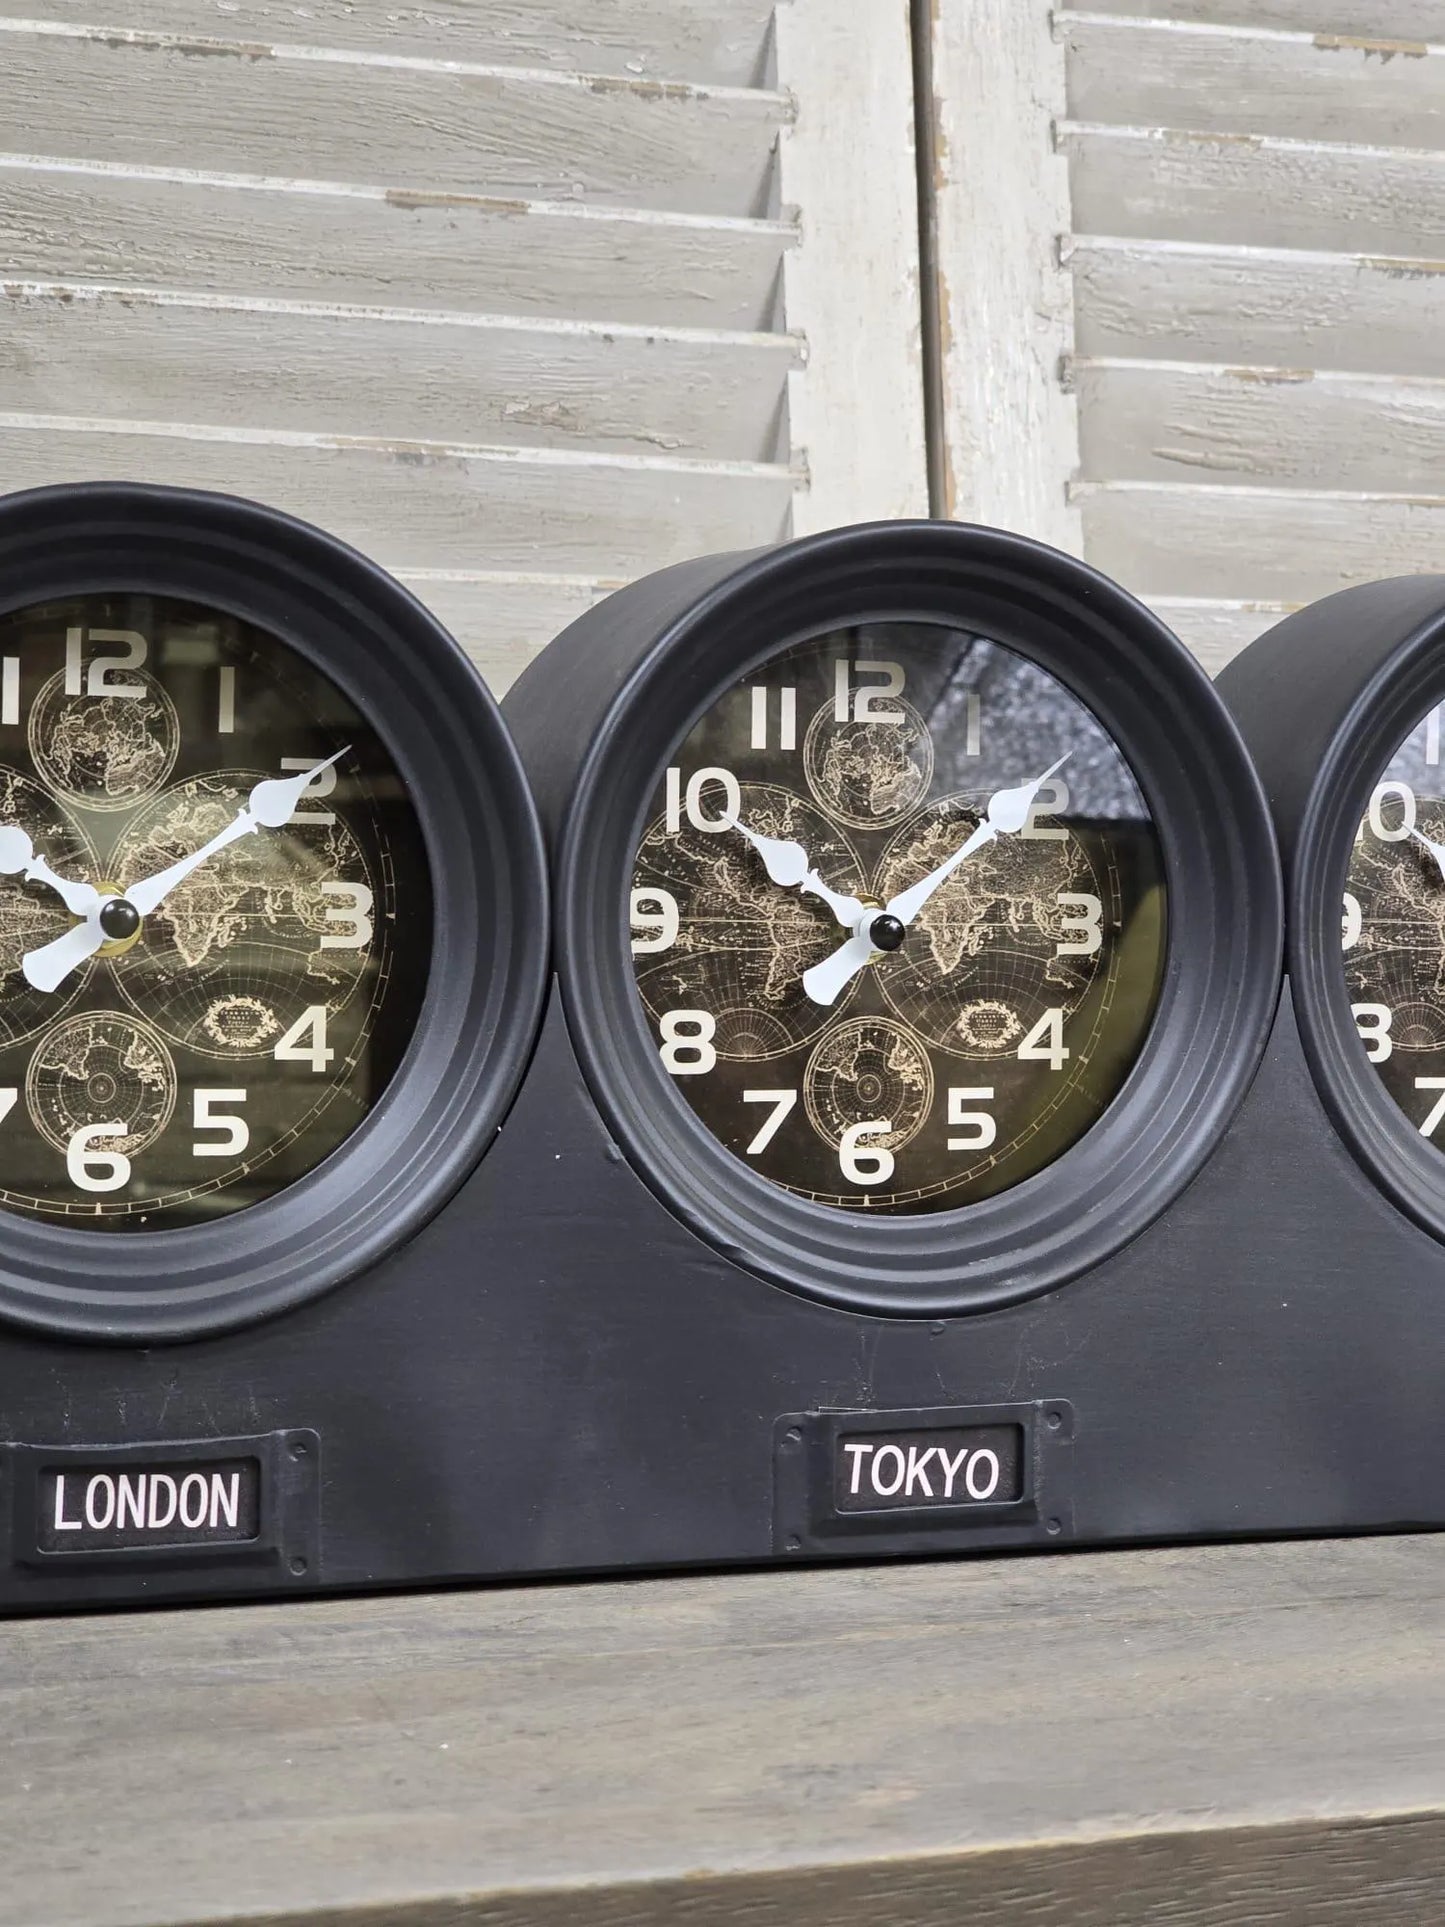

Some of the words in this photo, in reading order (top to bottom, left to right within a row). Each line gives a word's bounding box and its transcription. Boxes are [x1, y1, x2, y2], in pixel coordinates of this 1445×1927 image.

[2, 656, 20, 725] 1
[65, 627, 148, 697] 12
[834, 658, 906, 724] 12
[218, 666, 235, 733] 1
[750, 686, 797, 751] 11
[965, 693, 981, 756] 1
[280, 757, 338, 825] 2
[665, 766, 741, 832] 10
[1021, 777, 1070, 840] 2
[1354, 780, 1417, 842] 0
[320, 881, 374, 949] 3
[629, 886, 680, 954] 9
[1056, 892, 1103, 956] 3
[273, 1004, 335, 1073] 4
[658, 1009, 718, 1075] 8
[1016, 1007, 1070, 1071] 4
[192, 1088, 251, 1156] 5
[742, 1088, 798, 1155] 7
[946, 1086, 997, 1151] 5
[65, 1122, 132, 1193] 6
[838, 1120, 895, 1186] 6
[54, 1472, 241, 1531] LONDON
[844, 1443, 1000, 1500] TOKYO
